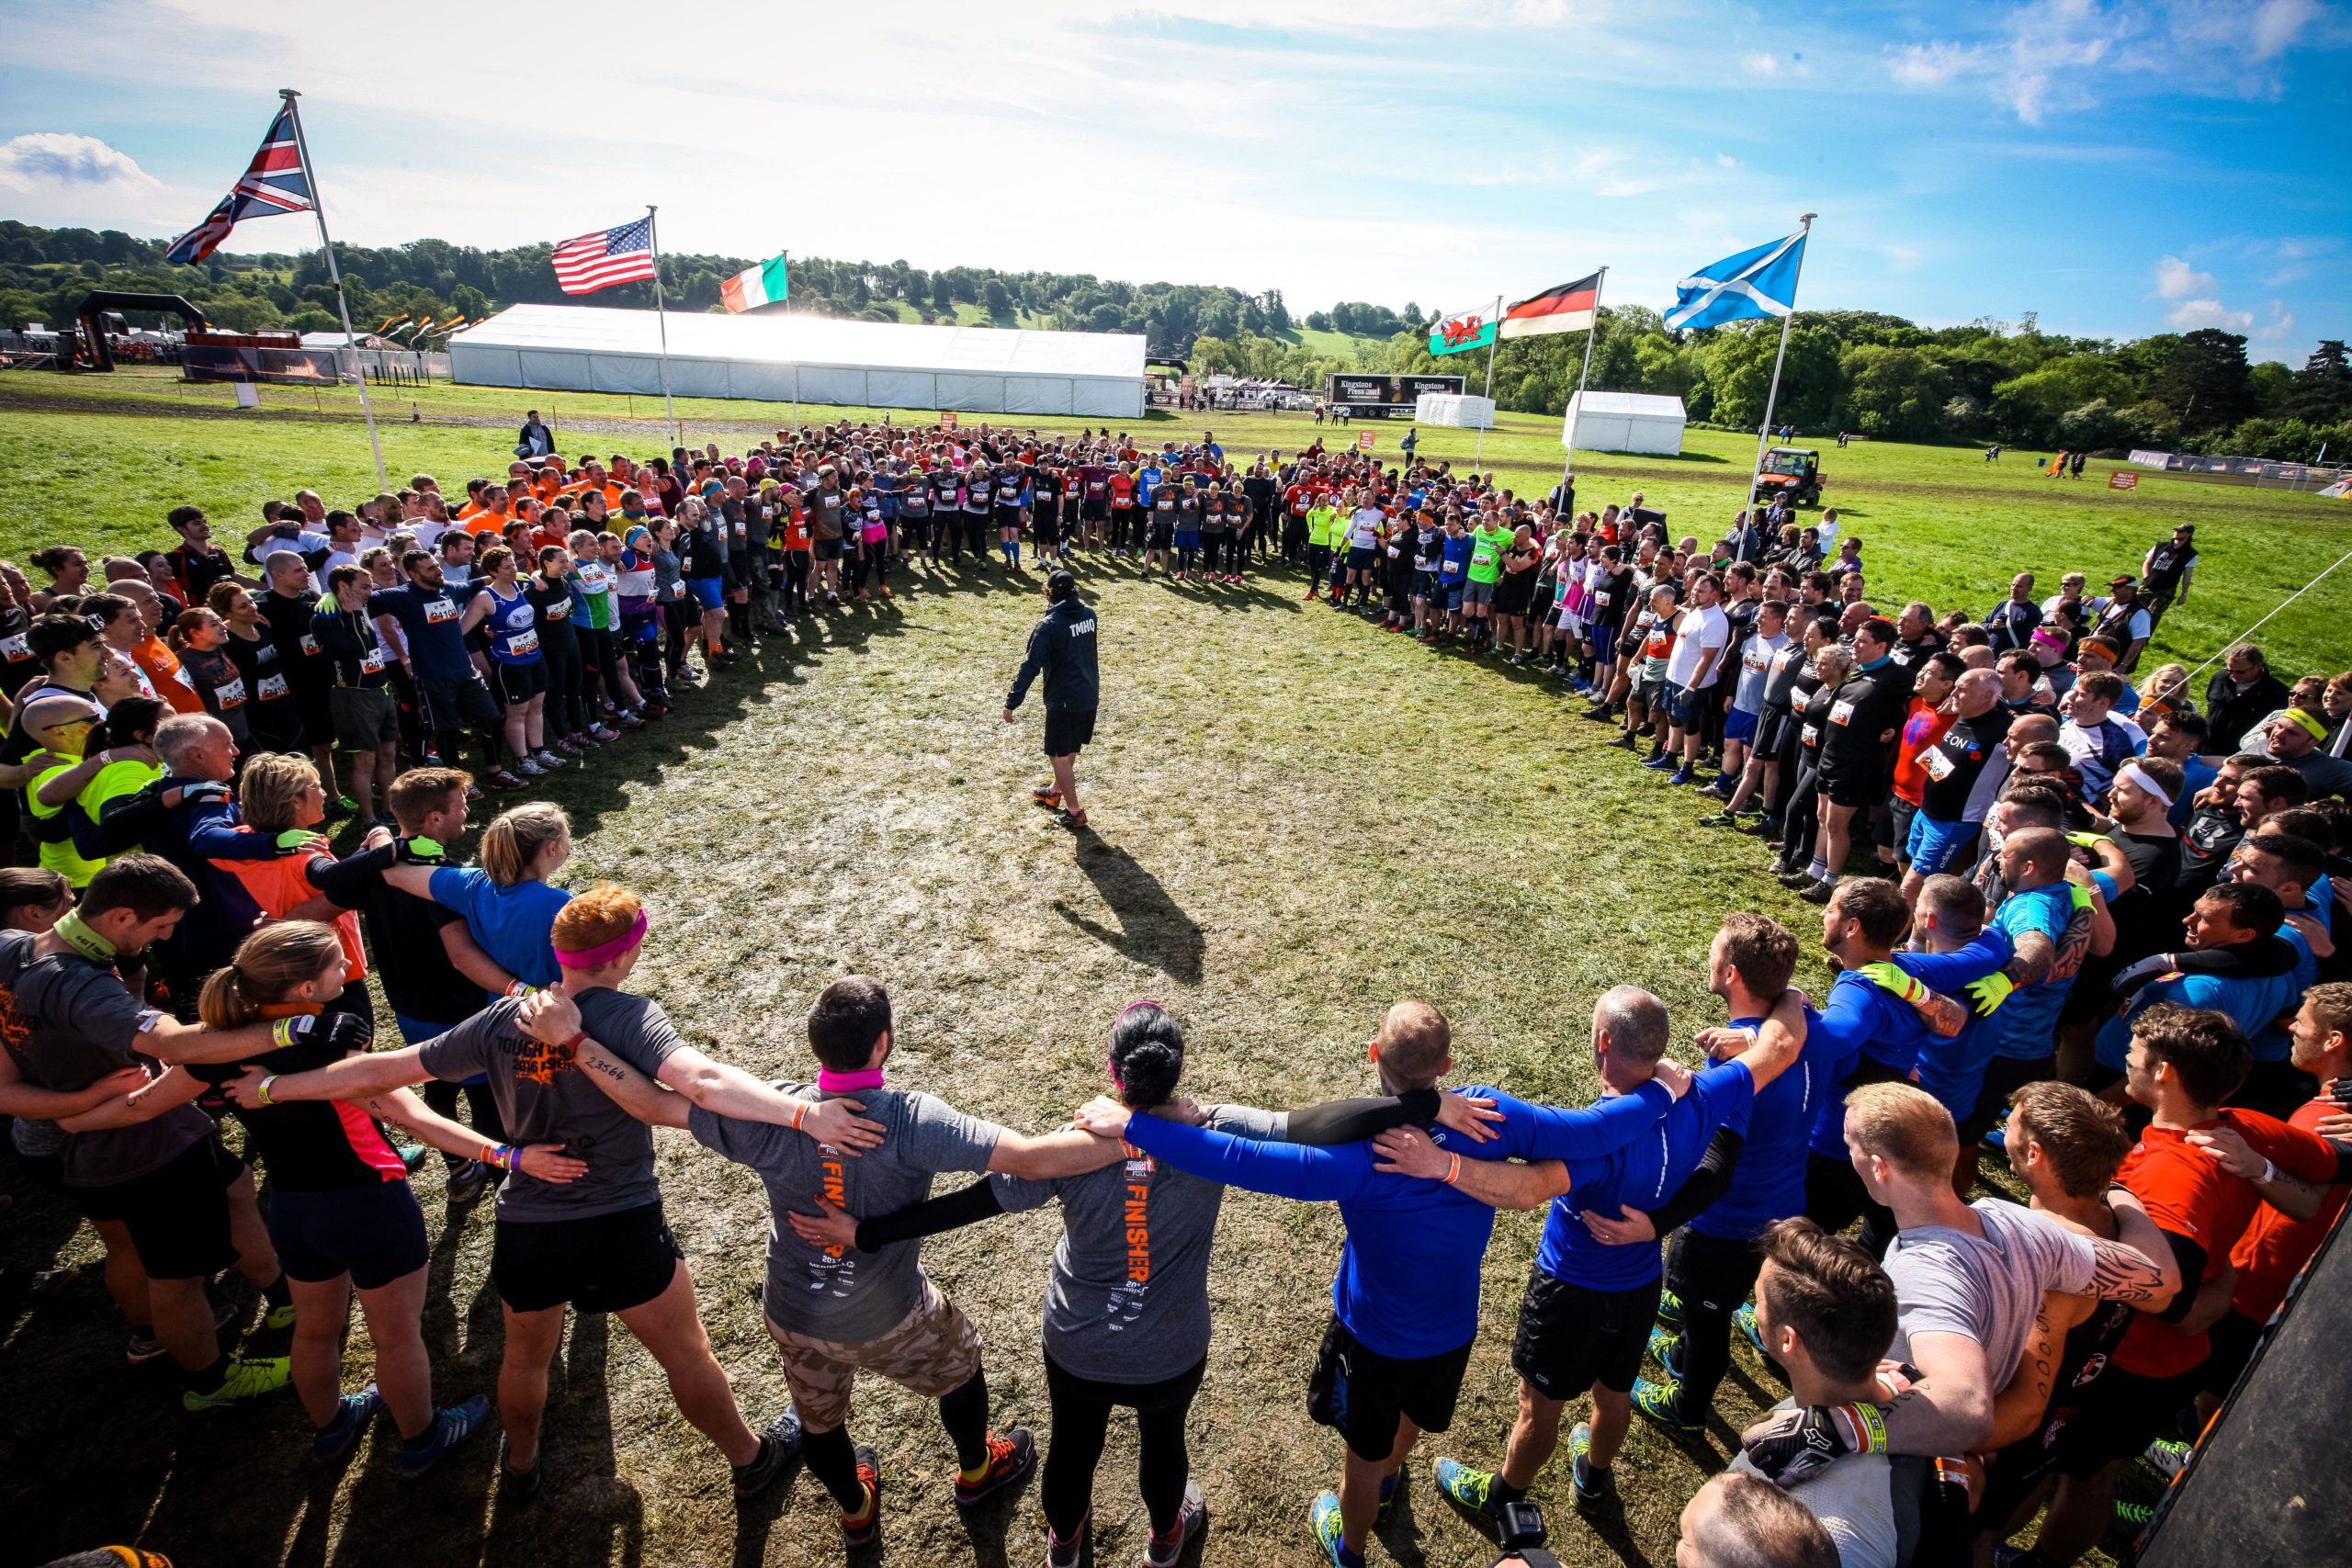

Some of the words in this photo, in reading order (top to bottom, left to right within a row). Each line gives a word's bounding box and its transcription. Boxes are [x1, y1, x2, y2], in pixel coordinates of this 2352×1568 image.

[1341, 380, 1373, 389] Kingstone
[1347, 387, 1365, 395] Press
[1414, 381, 1445, 390] Kingstone
[1069, 618, 1095, 637] TMHQ
[1950, 736, 1968, 750] ON
[1939, 843, 1958, 869] adidas
[497, 1036, 544, 1058] TOUGH
[514, 1057, 538, 1073] 2016
[586, 1056, 626, 1081] 23564
[1125, 1185, 1149, 1282] FINISHER
